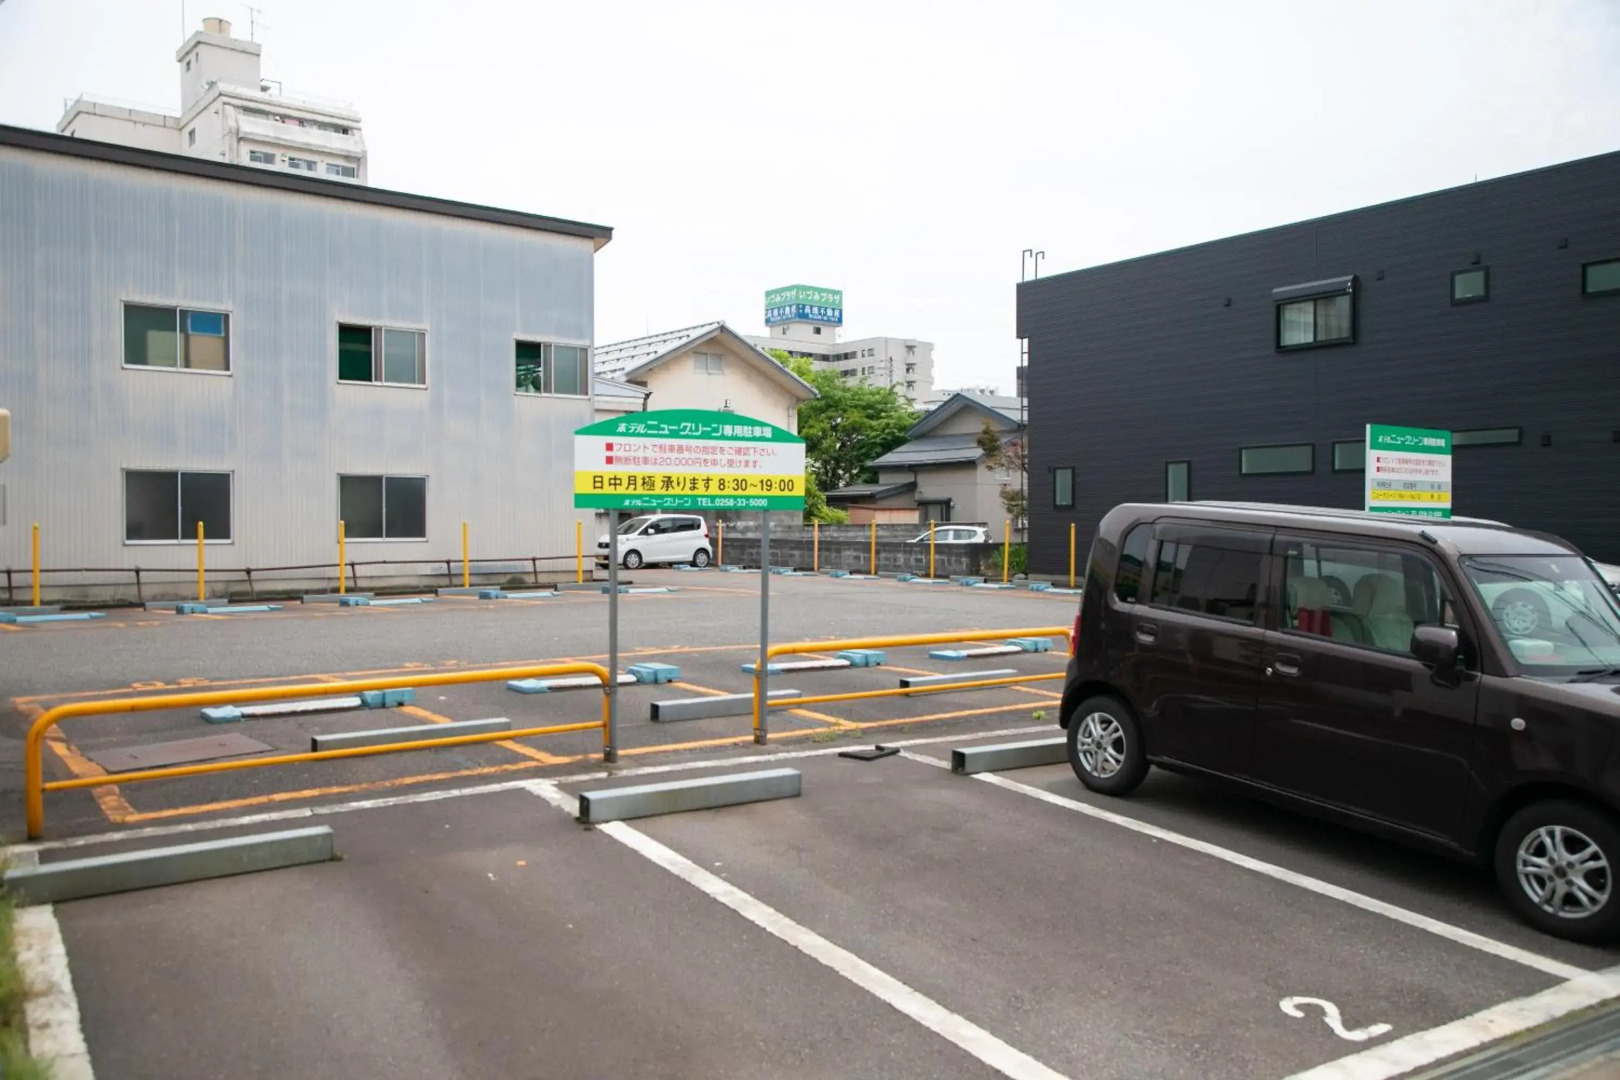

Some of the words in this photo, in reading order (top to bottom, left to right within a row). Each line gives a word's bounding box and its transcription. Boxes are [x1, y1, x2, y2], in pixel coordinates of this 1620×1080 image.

[616, 420, 772, 439] ホテルニューグリーン専用駐車場
[592, 475, 656, 491] 日中月極
[660, 475, 714, 492] 承ります
[623, 497, 691, 507] ホテルニューグリーン
[1279, 996, 1393, 1042] 2
